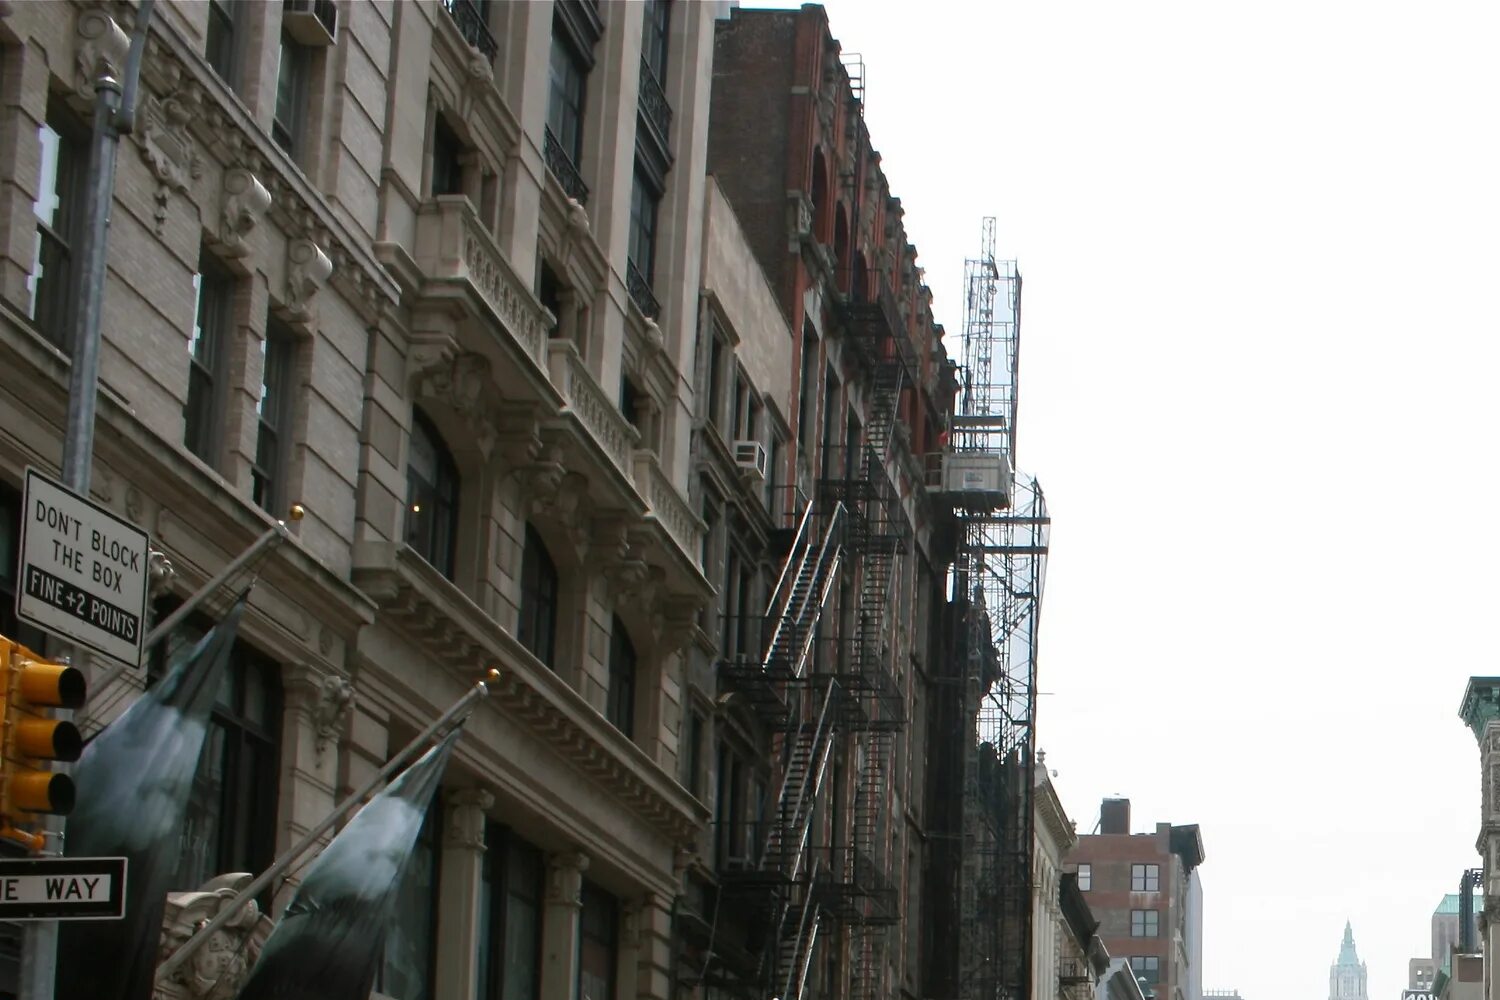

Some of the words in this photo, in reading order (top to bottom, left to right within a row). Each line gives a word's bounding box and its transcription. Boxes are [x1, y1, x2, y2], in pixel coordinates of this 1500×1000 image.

[36, 500, 82, 541] DON'T
[91, 529, 139, 573] BLOCK
[52, 539, 84, 574] THE
[92, 560, 123, 594] BOX
[31, 570, 64, 605] FINE
[65, 588, 85, 615] +2
[90, 599, 135, 640] POINTS
[45, 877, 100, 900] WAY
